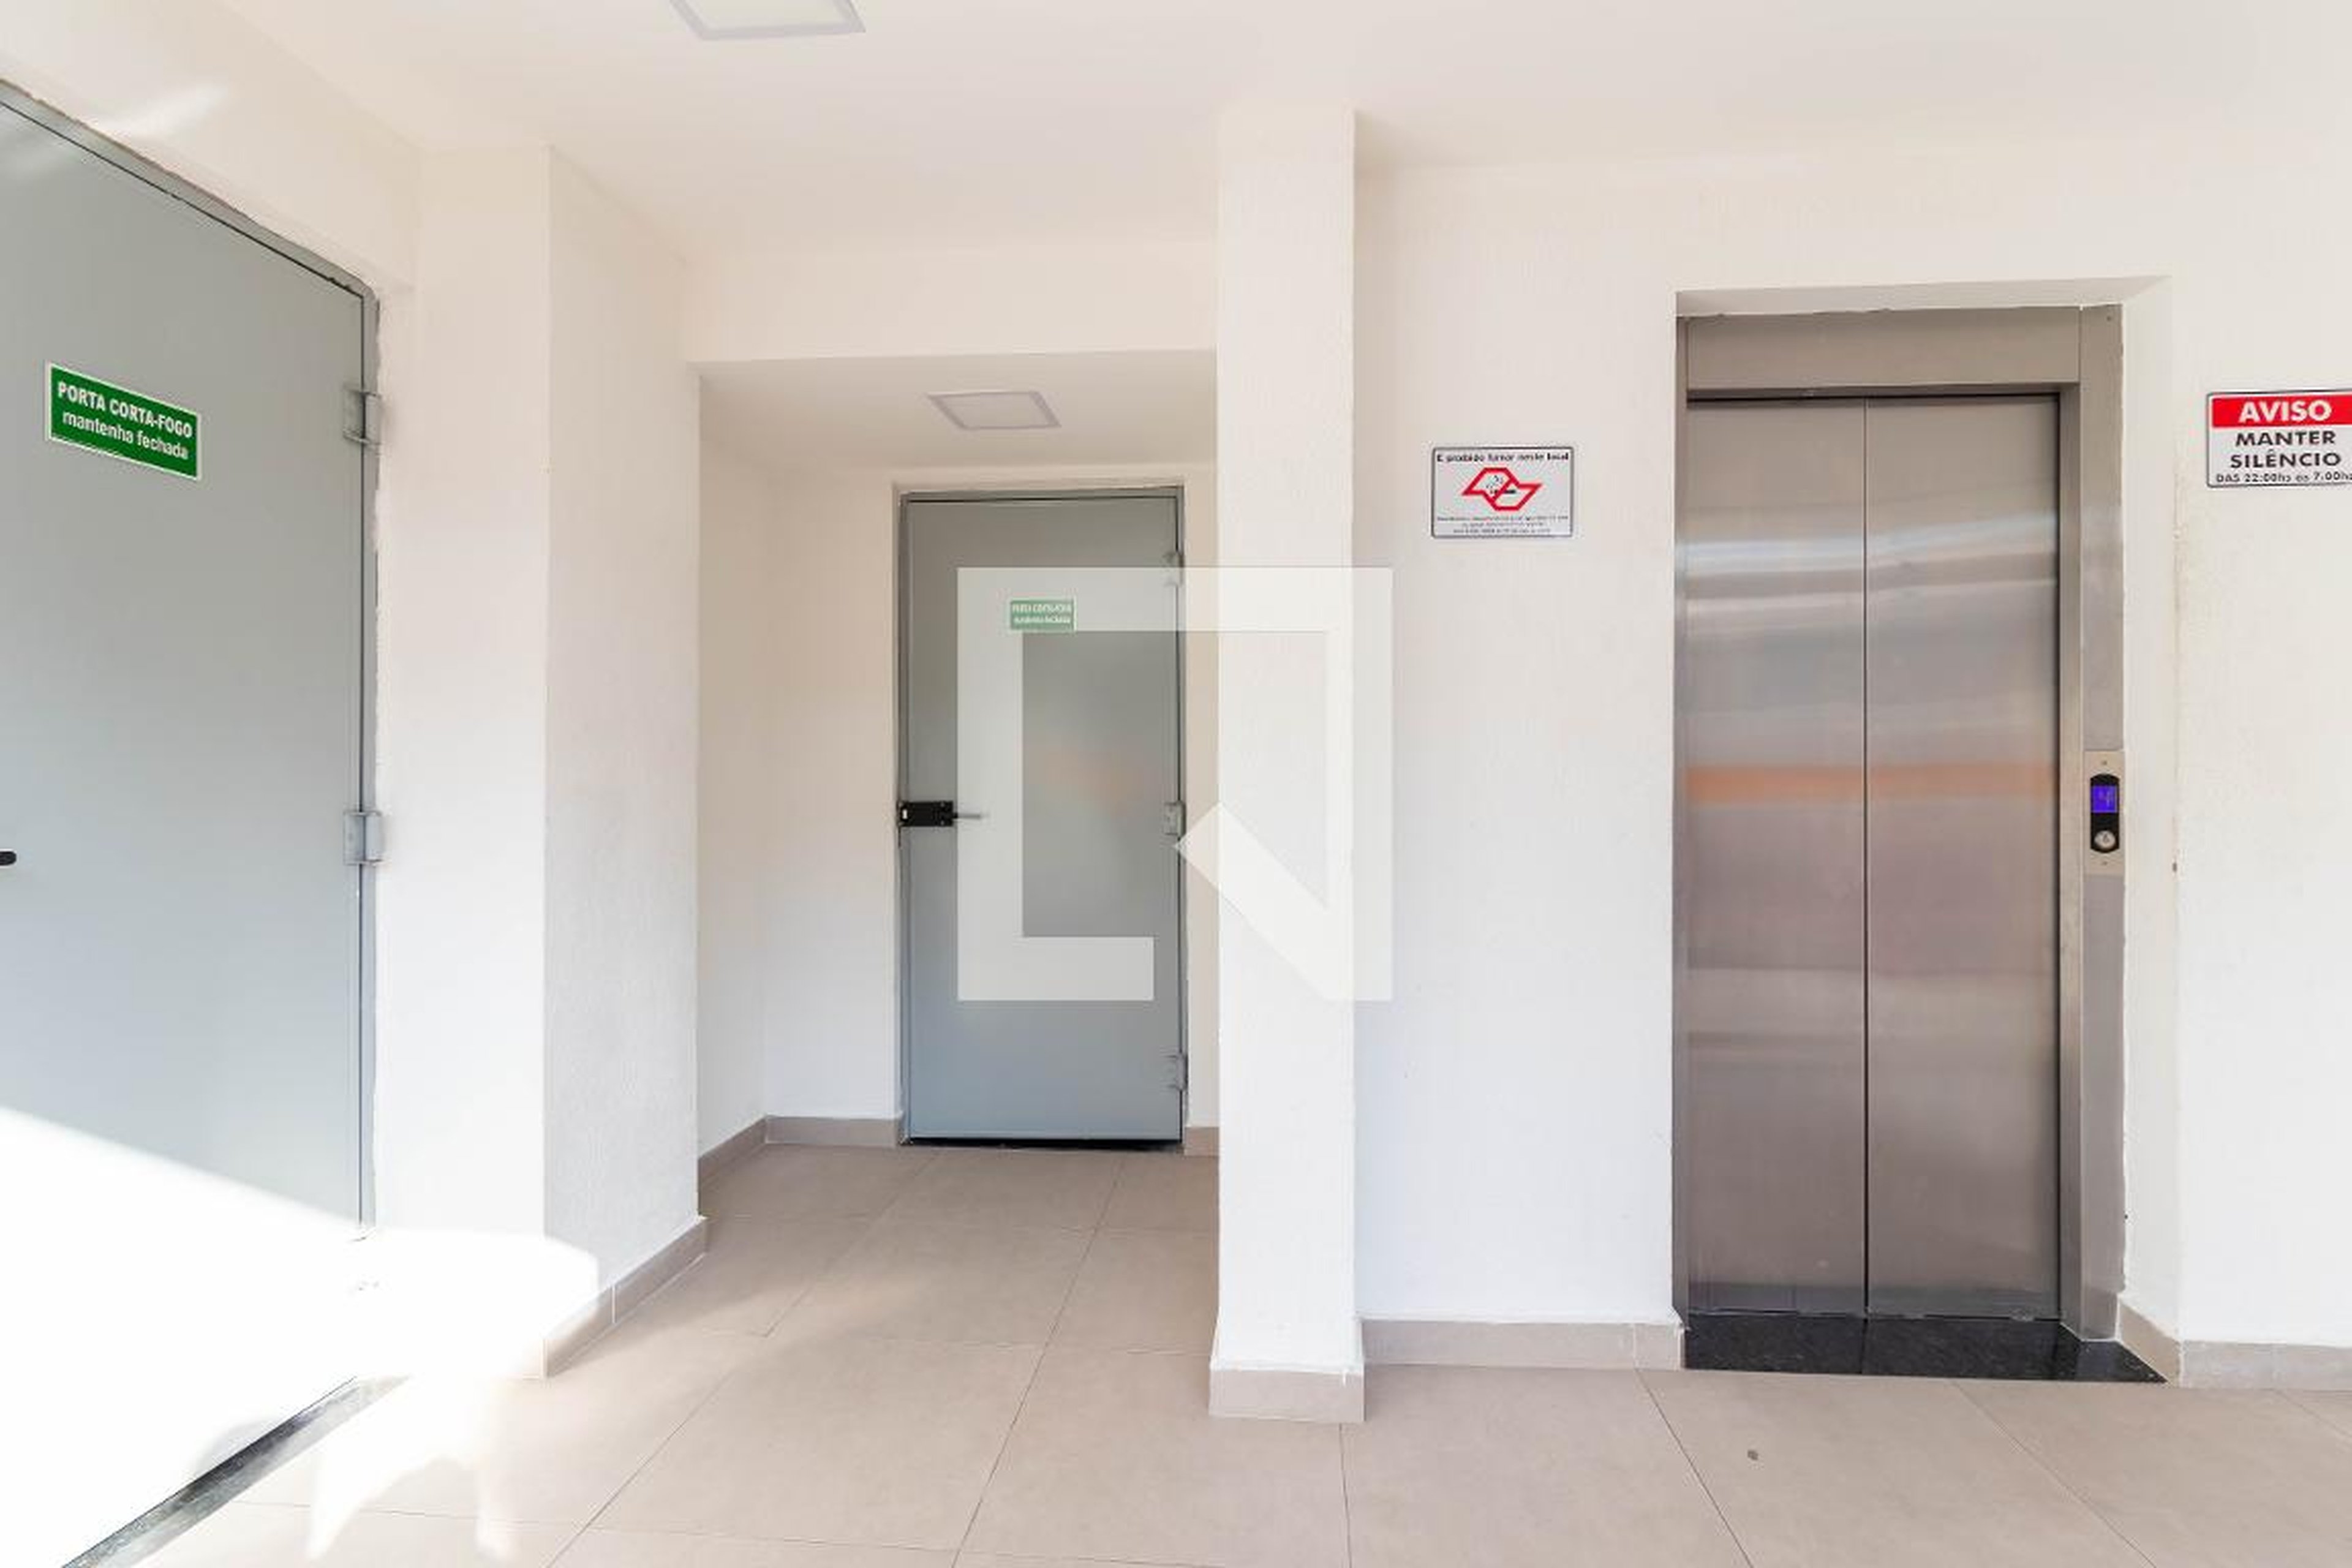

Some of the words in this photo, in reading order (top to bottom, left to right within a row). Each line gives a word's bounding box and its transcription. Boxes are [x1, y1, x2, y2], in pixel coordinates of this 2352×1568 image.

[58, 382, 105, 411] PORTA
[109, 399, 192, 438] CORTA-FOGO
[2239, 400, 2332, 423] AVISO
[62, 412, 134, 443] mantenha
[137, 431, 189, 459] fechada
[2236, 431, 2335, 447] MANTER
[2230, 448, 2341, 469] SILÊNCIO
[2216, 473, 2240, 483] DAS
